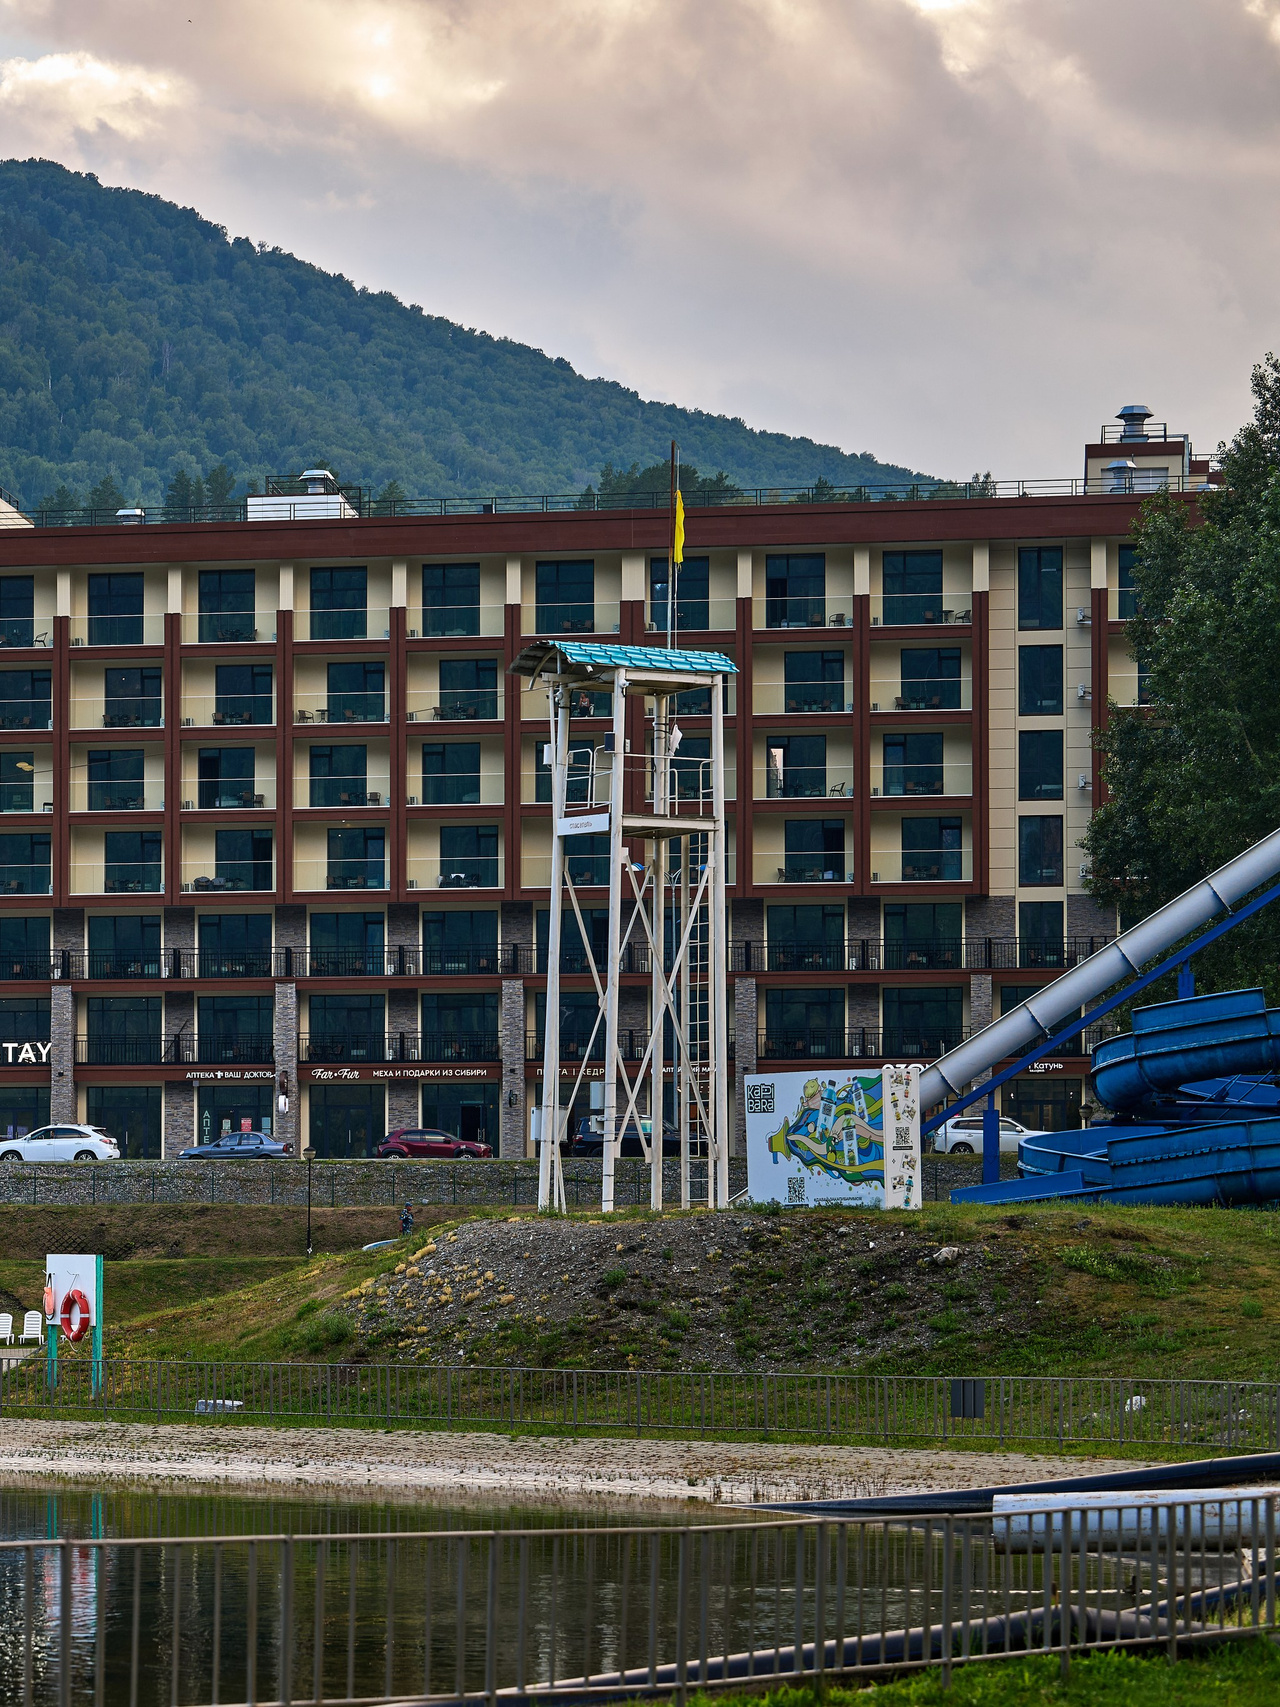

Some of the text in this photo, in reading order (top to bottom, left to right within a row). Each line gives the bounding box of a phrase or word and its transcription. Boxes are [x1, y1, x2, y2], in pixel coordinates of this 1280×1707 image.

[185, 1071, 215, 1079] АПТЕКА
[243, 1070, 272, 1079] ДОКТОР
[402, 1069, 440, 1078] ПОДАРКИ
